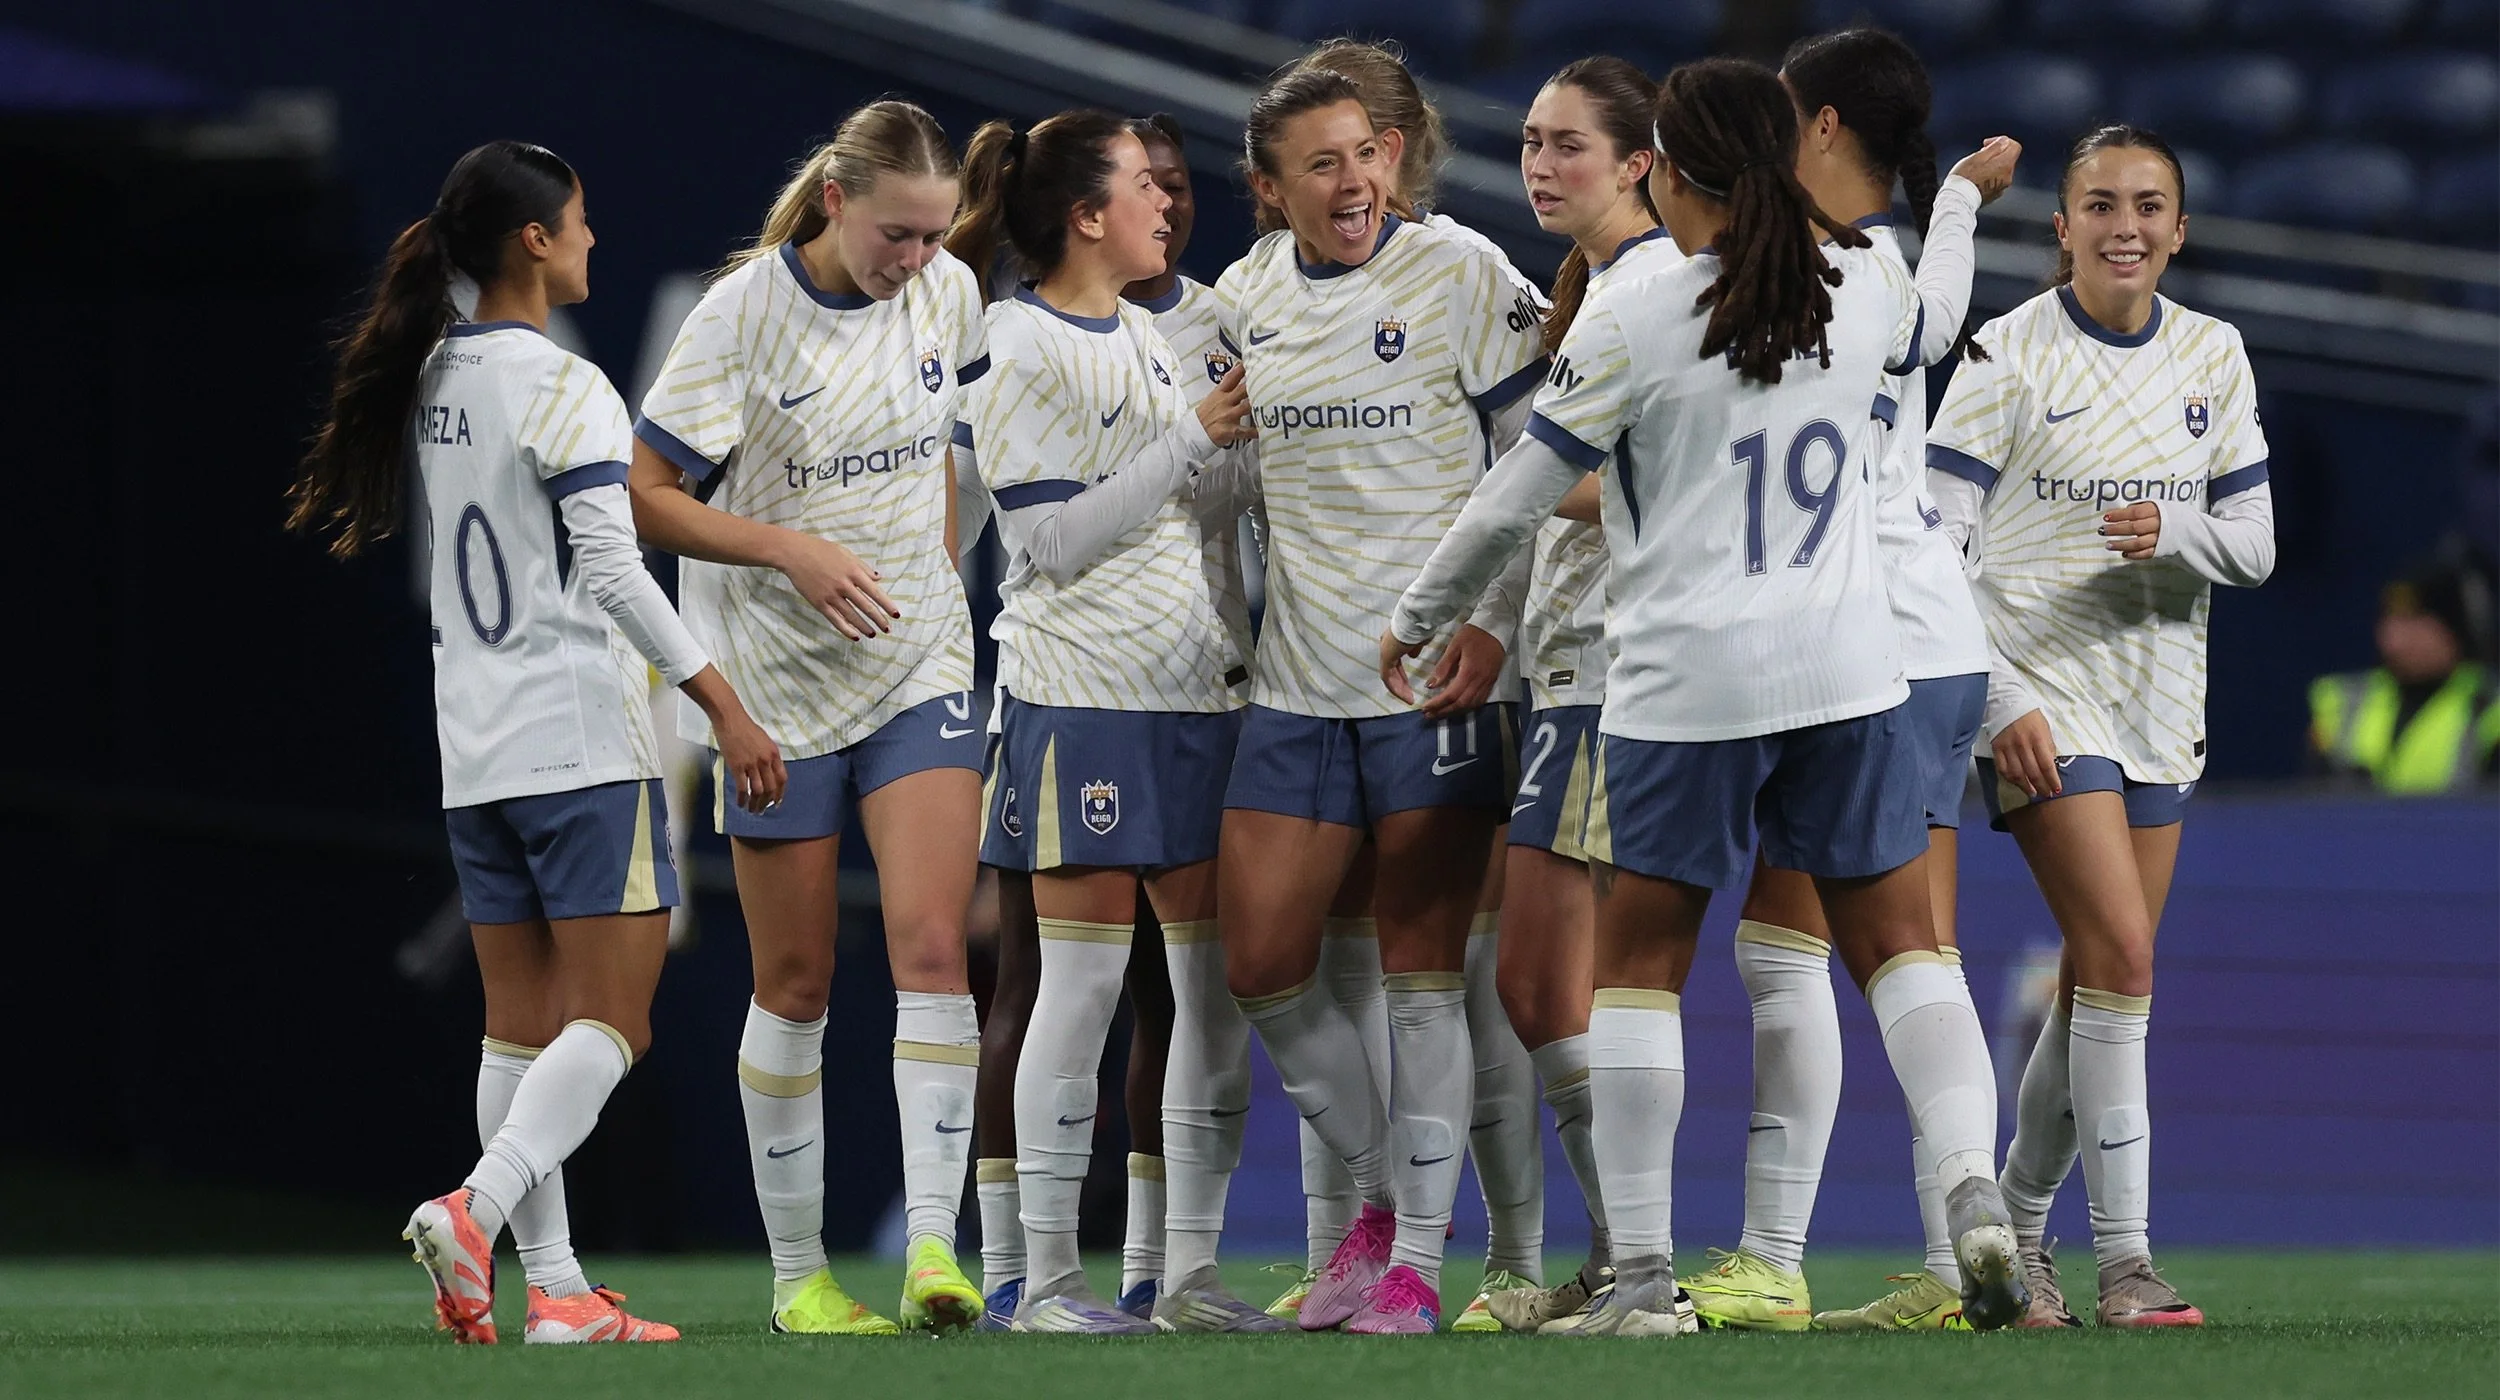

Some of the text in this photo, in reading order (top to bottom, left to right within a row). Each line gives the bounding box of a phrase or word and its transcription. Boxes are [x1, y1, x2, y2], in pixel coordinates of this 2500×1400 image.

[1506, 296, 1540, 333] ally
[445, 351, 483, 366] CHOICE
[1380, 345, 1400, 355] REIGN
[1549, 354, 1585, 397] lly
[420, 405, 472, 447] MEZA
[1253, 398, 1411, 439] rupanion
[784, 436, 937, 488] trupanio
[1730, 418, 1847, 577] 19
[430, 501, 513, 648] 0
[1517, 721, 1558, 797] 2
[1091, 813, 1111, 824] REIGN
